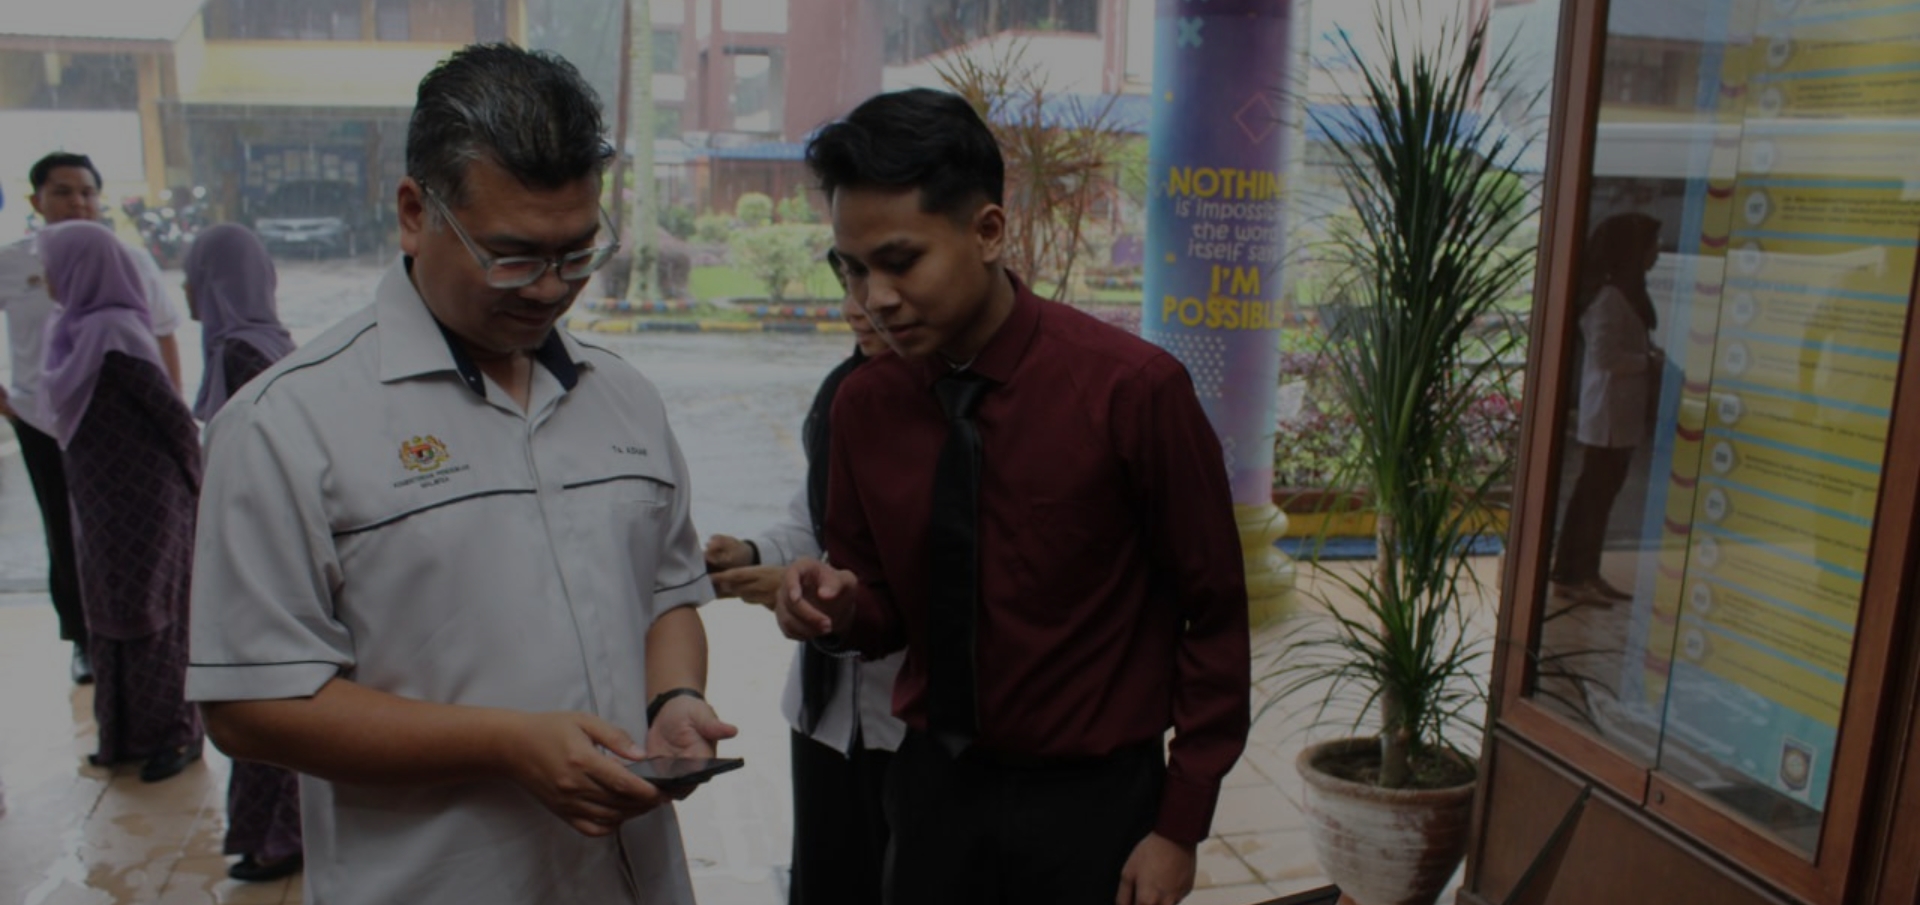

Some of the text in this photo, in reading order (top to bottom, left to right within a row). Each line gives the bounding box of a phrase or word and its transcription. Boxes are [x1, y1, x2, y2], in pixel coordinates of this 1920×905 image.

[1168, 166, 1286, 200] NOTHIN
[1175, 197, 1191, 218] is
[1193, 222, 1229, 240] the
[1187, 238, 1244, 263] itself
[1210, 264, 1260, 295] I'M
